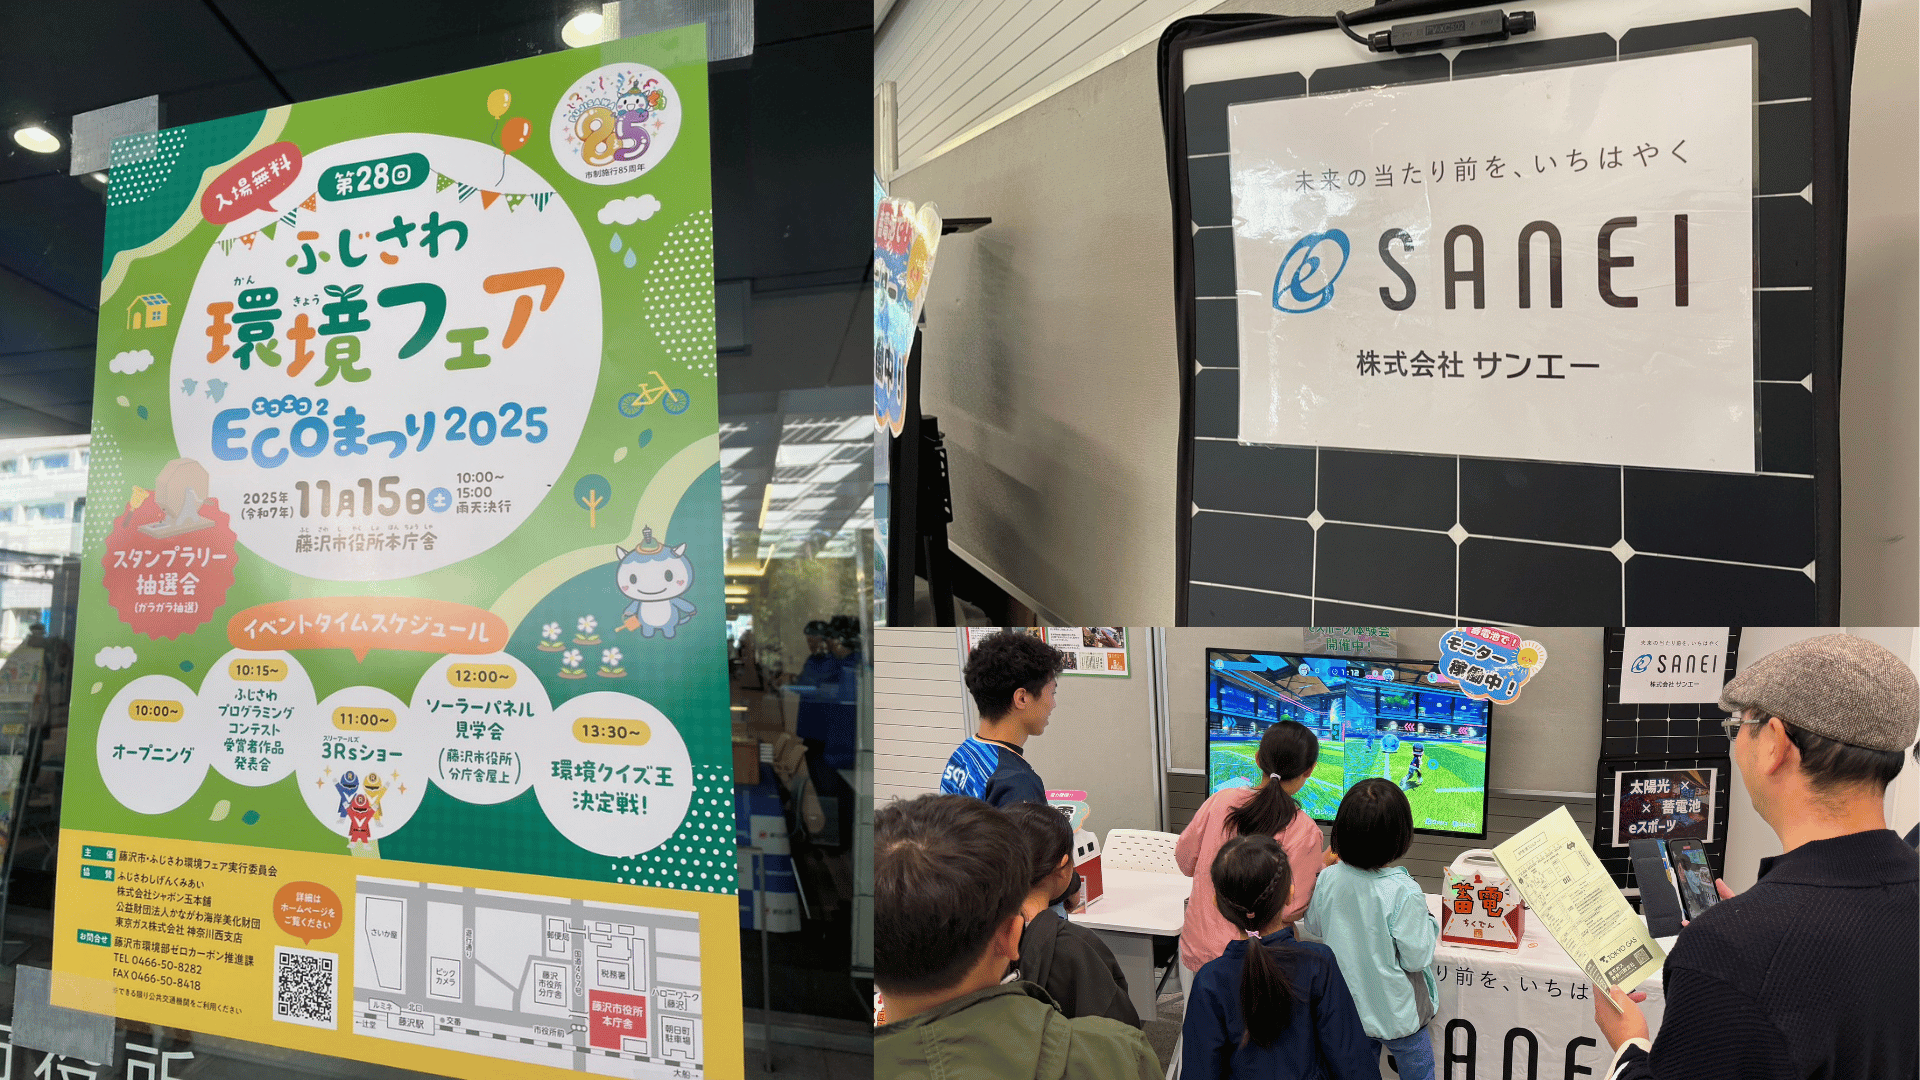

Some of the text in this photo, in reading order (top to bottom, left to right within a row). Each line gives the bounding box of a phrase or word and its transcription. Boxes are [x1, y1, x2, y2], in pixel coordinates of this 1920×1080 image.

[574, 107, 650, 167] 85
[585, 164, 645, 179] 市制施行85周年
[1295, 139, 1689, 192] 未来の当たり前を、いちはやく
[215, 153, 292, 212] 入場無料
[334, 162, 412, 196] 第28回
[286, 211, 469, 275] ふじさわ
[1378, 213, 1689, 310] SANEI
[233, 275, 255, 286] かん
[293, 295, 320, 307] きょう
[205, 267, 565, 387] 環境フェア
[1356, 349, 1600, 380] 株式会社 サンエー
[444, 401, 548, 446] 2025
[456, 471, 504, 484] 10:00~
[243, 491, 289, 505] 2025年
[295, 475, 426, 519] 11月15日
[457, 486, 492, 499] 15:00
[240, 506, 294, 521] (令和7年)
[456, 500, 512, 515] 雨天決行
[295, 531, 438, 553] 藤沢市役所本庁舎
[113, 545, 228, 569] スタンプラリー
[136, 572, 200, 596] 抽選会
[134, 602, 199, 614] (ガラガラ抽選)
[243, 611, 489, 643] イベントタイムスケジュール
[1446, 635, 1507, 663] モニター
[236, 664, 280, 677] 10:15~
[1657, 654, 1717, 674] SANEI
[455, 669, 510, 684] 12:00~
[234, 688, 278, 702] ふじさわ
[135, 705, 179, 717] 10:00~
[218, 703, 295, 720] プログラミング
[426, 697, 535, 718] ソーラーパネル
[340, 712, 390, 727] 11:00~
[229, 722, 281, 736] コンテスト
[456, 721, 505, 741] 見学会
[582, 724, 641, 739] 13:30~
[112, 743, 195, 765] オープニング
[224, 738, 285, 755] 受賞者作品
[321, 742, 403, 762] 3Rsショー
[234, 756, 271, 772] 発表会
[551, 758, 675, 788] 環境クイズ王
[1630, 779, 1671, 795] 太陽光
[572, 790, 648, 816] 決定戦!
[1661, 799, 1702, 815] 蓄電池
[1629, 819, 1677, 834] eスポーツ
[118, 850, 278, 878] 藤沢市・ふじさわ環境フェア実行委員会
[117, 871, 205, 890] ふじさわしげんくみあい
[116, 886, 212, 908] 株式会社シャボン玉本舗
[295, 891, 322, 904] 詳細は
[1451, 882, 1504, 918] 蓄電
[116, 901, 261, 930] 公益財団法人かながわ海岸美化財団
[280, 902, 336, 919] ホームページを
[115, 915, 243, 944] 東京ガス株式会社 神奈川西支店
[284, 916, 331, 930] ご覧ください
[1463, 918, 1495, 929] ちくでん
[79, 931, 109, 945] お問合せ
[371, 929, 397, 939] さいか屋
[547, 931, 570, 942] 郵便局
[114, 936, 255, 967] 藤沢市環境部ゼロカーボン推進課
[113, 953, 203, 975] TEL 0466-50-8282
[435, 967, 456, 977] ビック
[112, 968, 202, 991] FAX 0466-50-8418
[435, 977, 456, 986] カメラ
[542, 971, 558, 980] 藤沢
[601, 969, 626, 981] 税務署
[1436, 965, 1589, 1001] り前を、いちは
[538, 979, 562, 990] 市役所
[538, 989, 562, 999] 分庁舎
[652, 988, 699, 1001] ハローワーク
[373, 1001, 393, 1011] ルミネ
[408, 1003, 422, 1012] 北口
[592, 1000, 643, 1017] 藤沢市役所
[398, 1017, 424, 1029] 藤沢駅
[446, 1017, 461, 1026] 交番
[602, 1015, 633, 1030] 本庁舎
[665, 1024, 690, 1035] 朝日町
[534, 1026, 565, 1038] 市役所前
[1387, 1018, 1597, 1080] ANE
